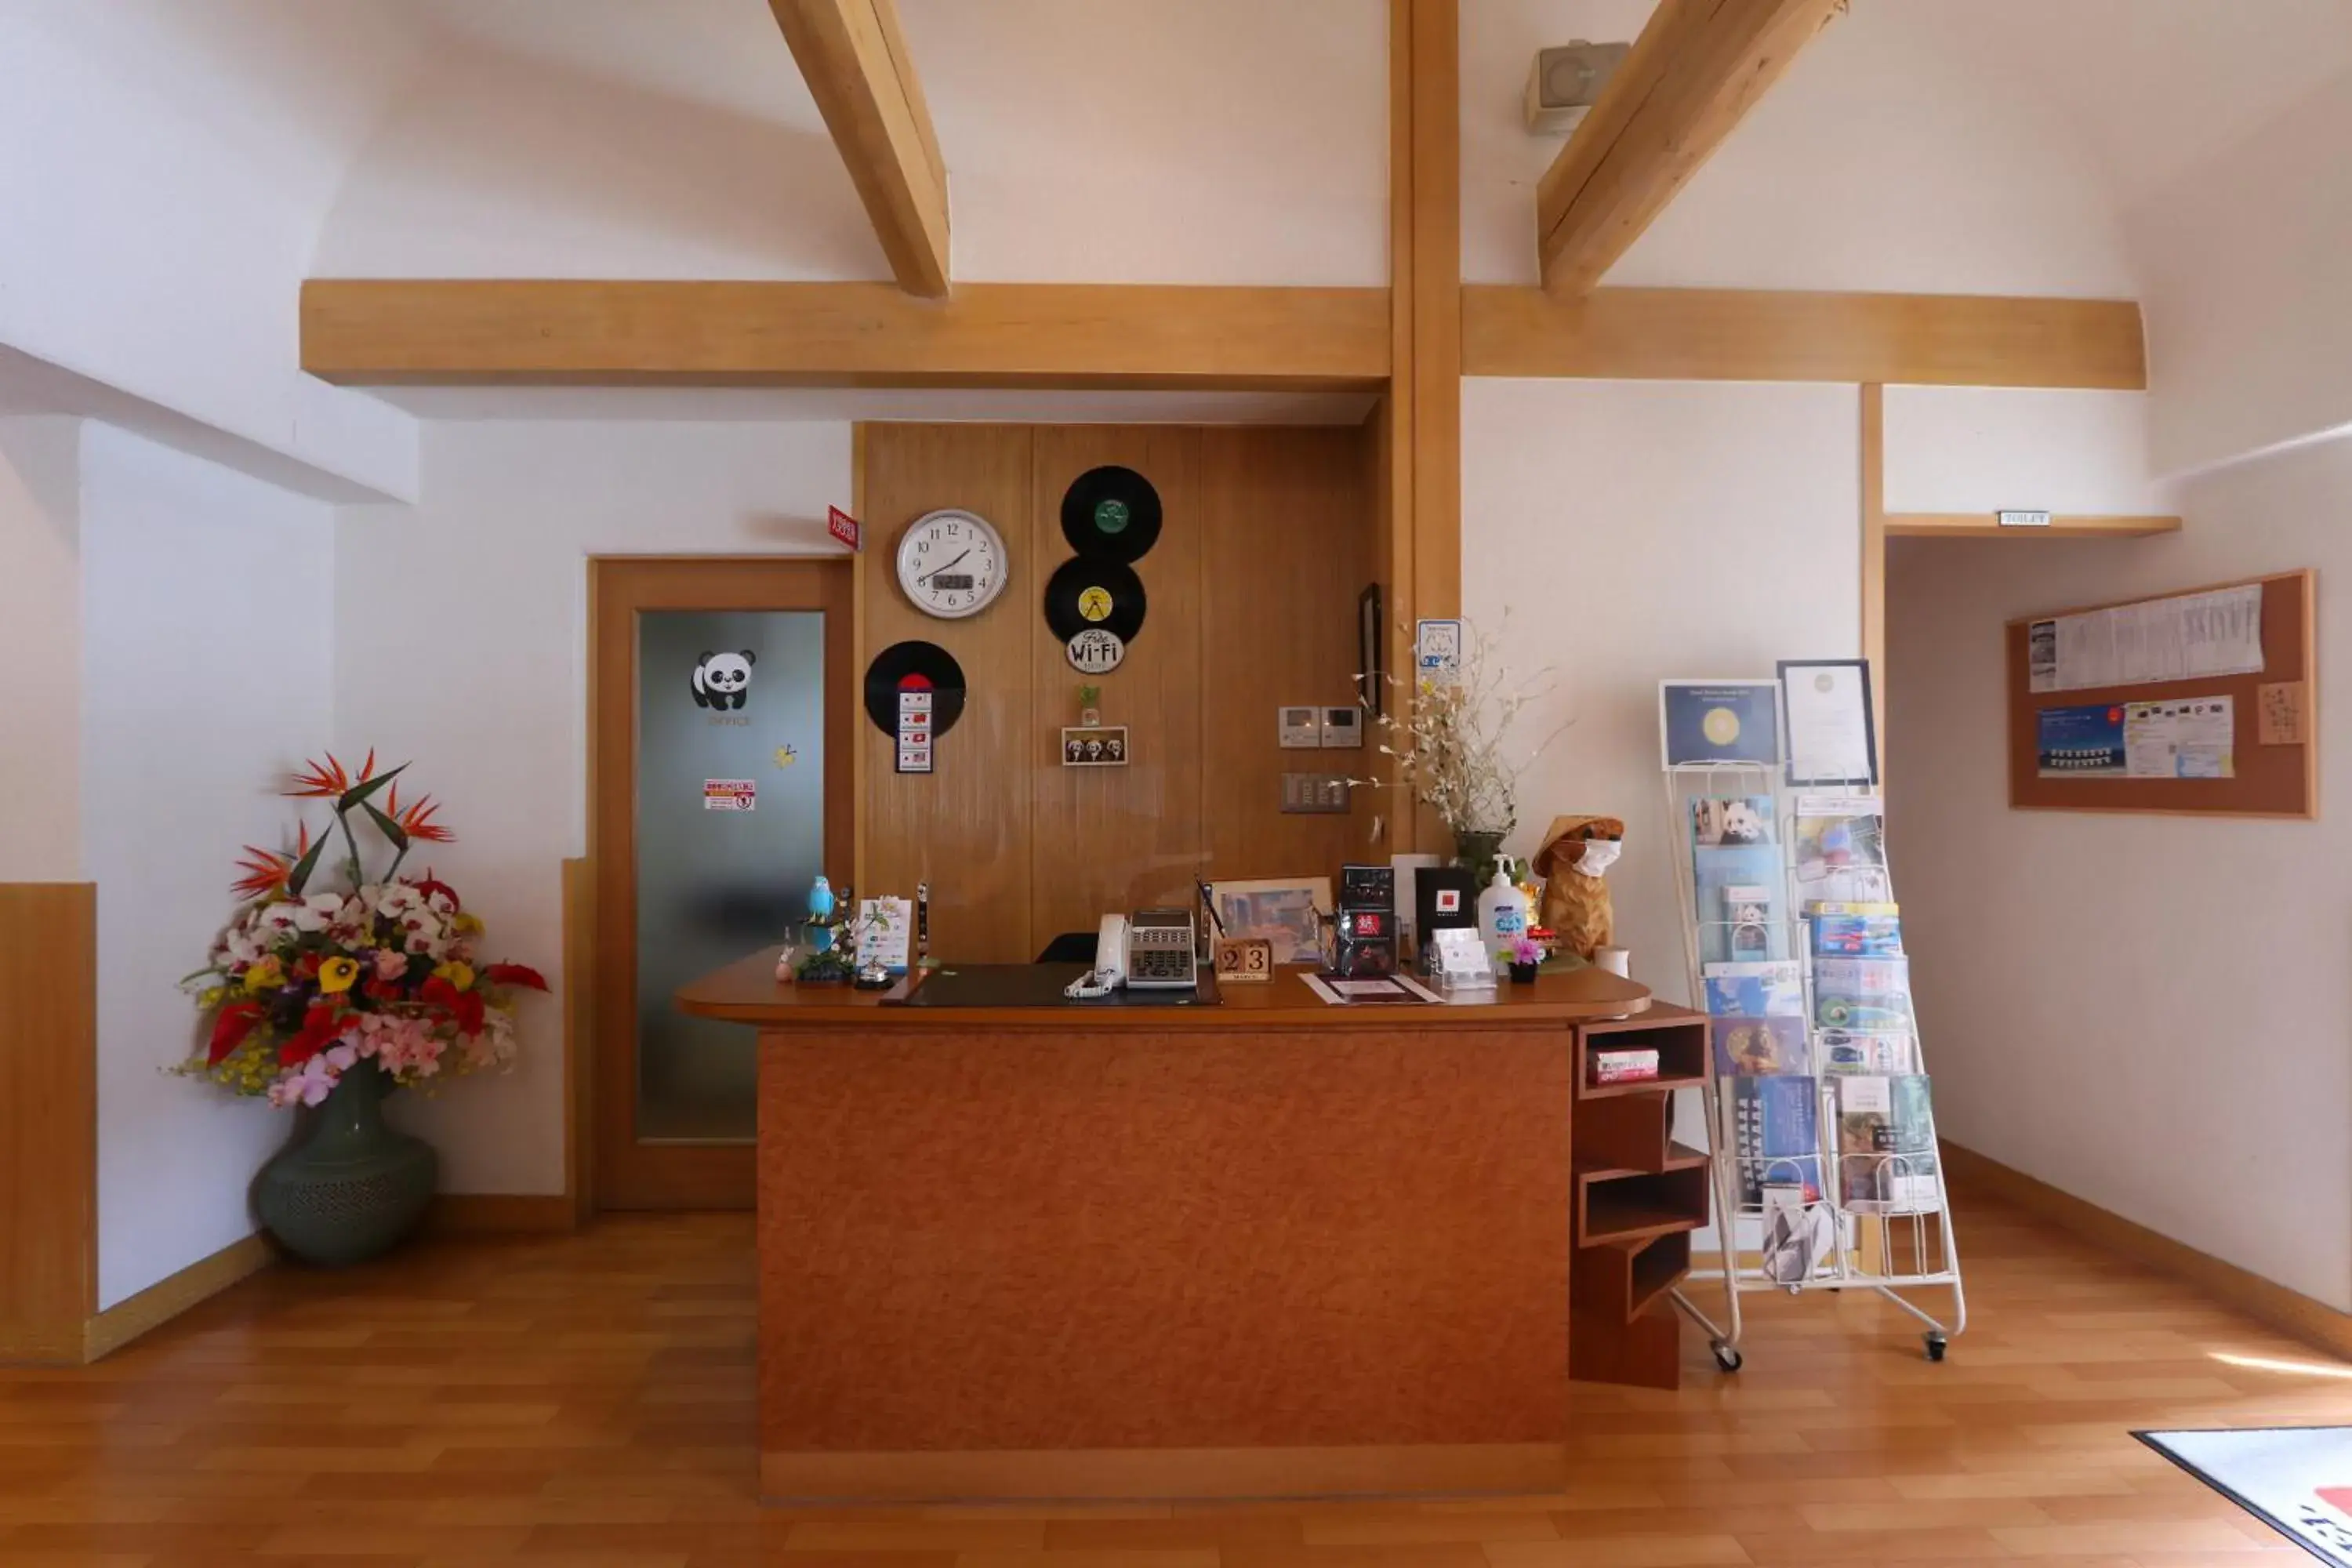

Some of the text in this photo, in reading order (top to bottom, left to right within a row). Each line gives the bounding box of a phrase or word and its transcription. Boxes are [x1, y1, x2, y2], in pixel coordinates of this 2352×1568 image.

[930, 528, 940, 540] 11
[947, 523, 959, 535] 12
[968, 529, 973, 540] 1
[917, 541, 929, 554] 10
[978, 540, 987, 553] 2
[913, 557, 921, 570] 9
[984, 559, 992, 572] 3
[978, 577, 986, 588] 4
[931, 590, 938, 601] 7
[948, 593, 956, 606] 6
[967, 590, 975, 603] 5
[1081, 631, 1109, 644] Free
[1070, 643, 1118, 662] Wi-Fi
